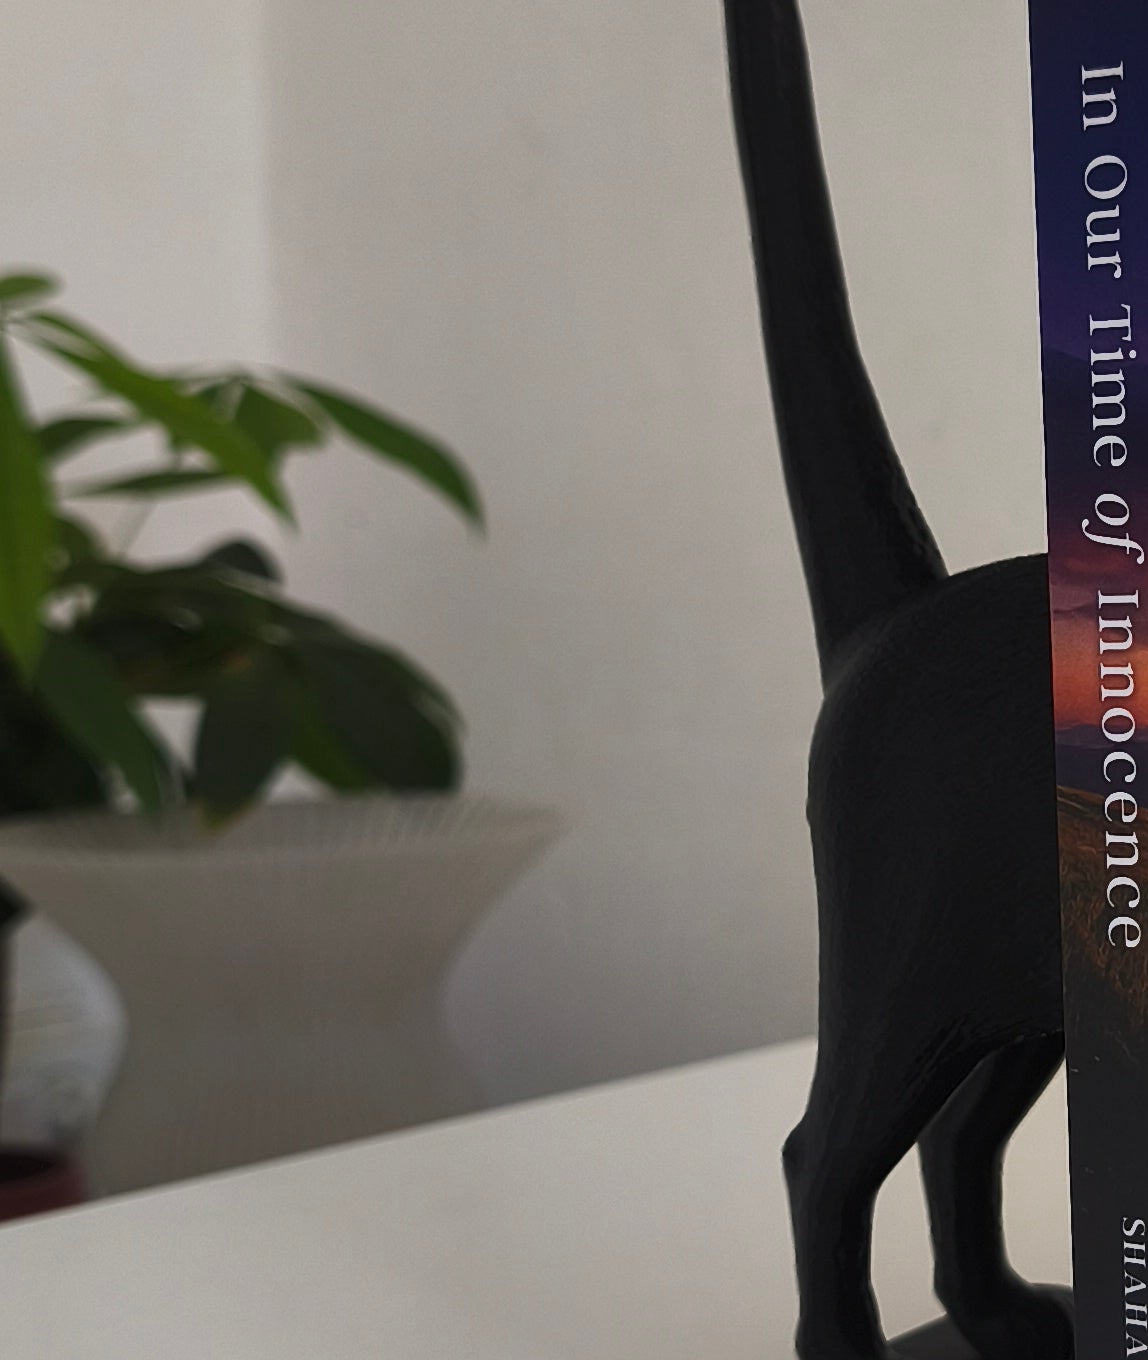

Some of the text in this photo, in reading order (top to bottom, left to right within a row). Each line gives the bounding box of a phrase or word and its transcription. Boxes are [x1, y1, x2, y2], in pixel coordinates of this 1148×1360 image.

[1080, 60, 1146, 949] In Our Time of Innocence
